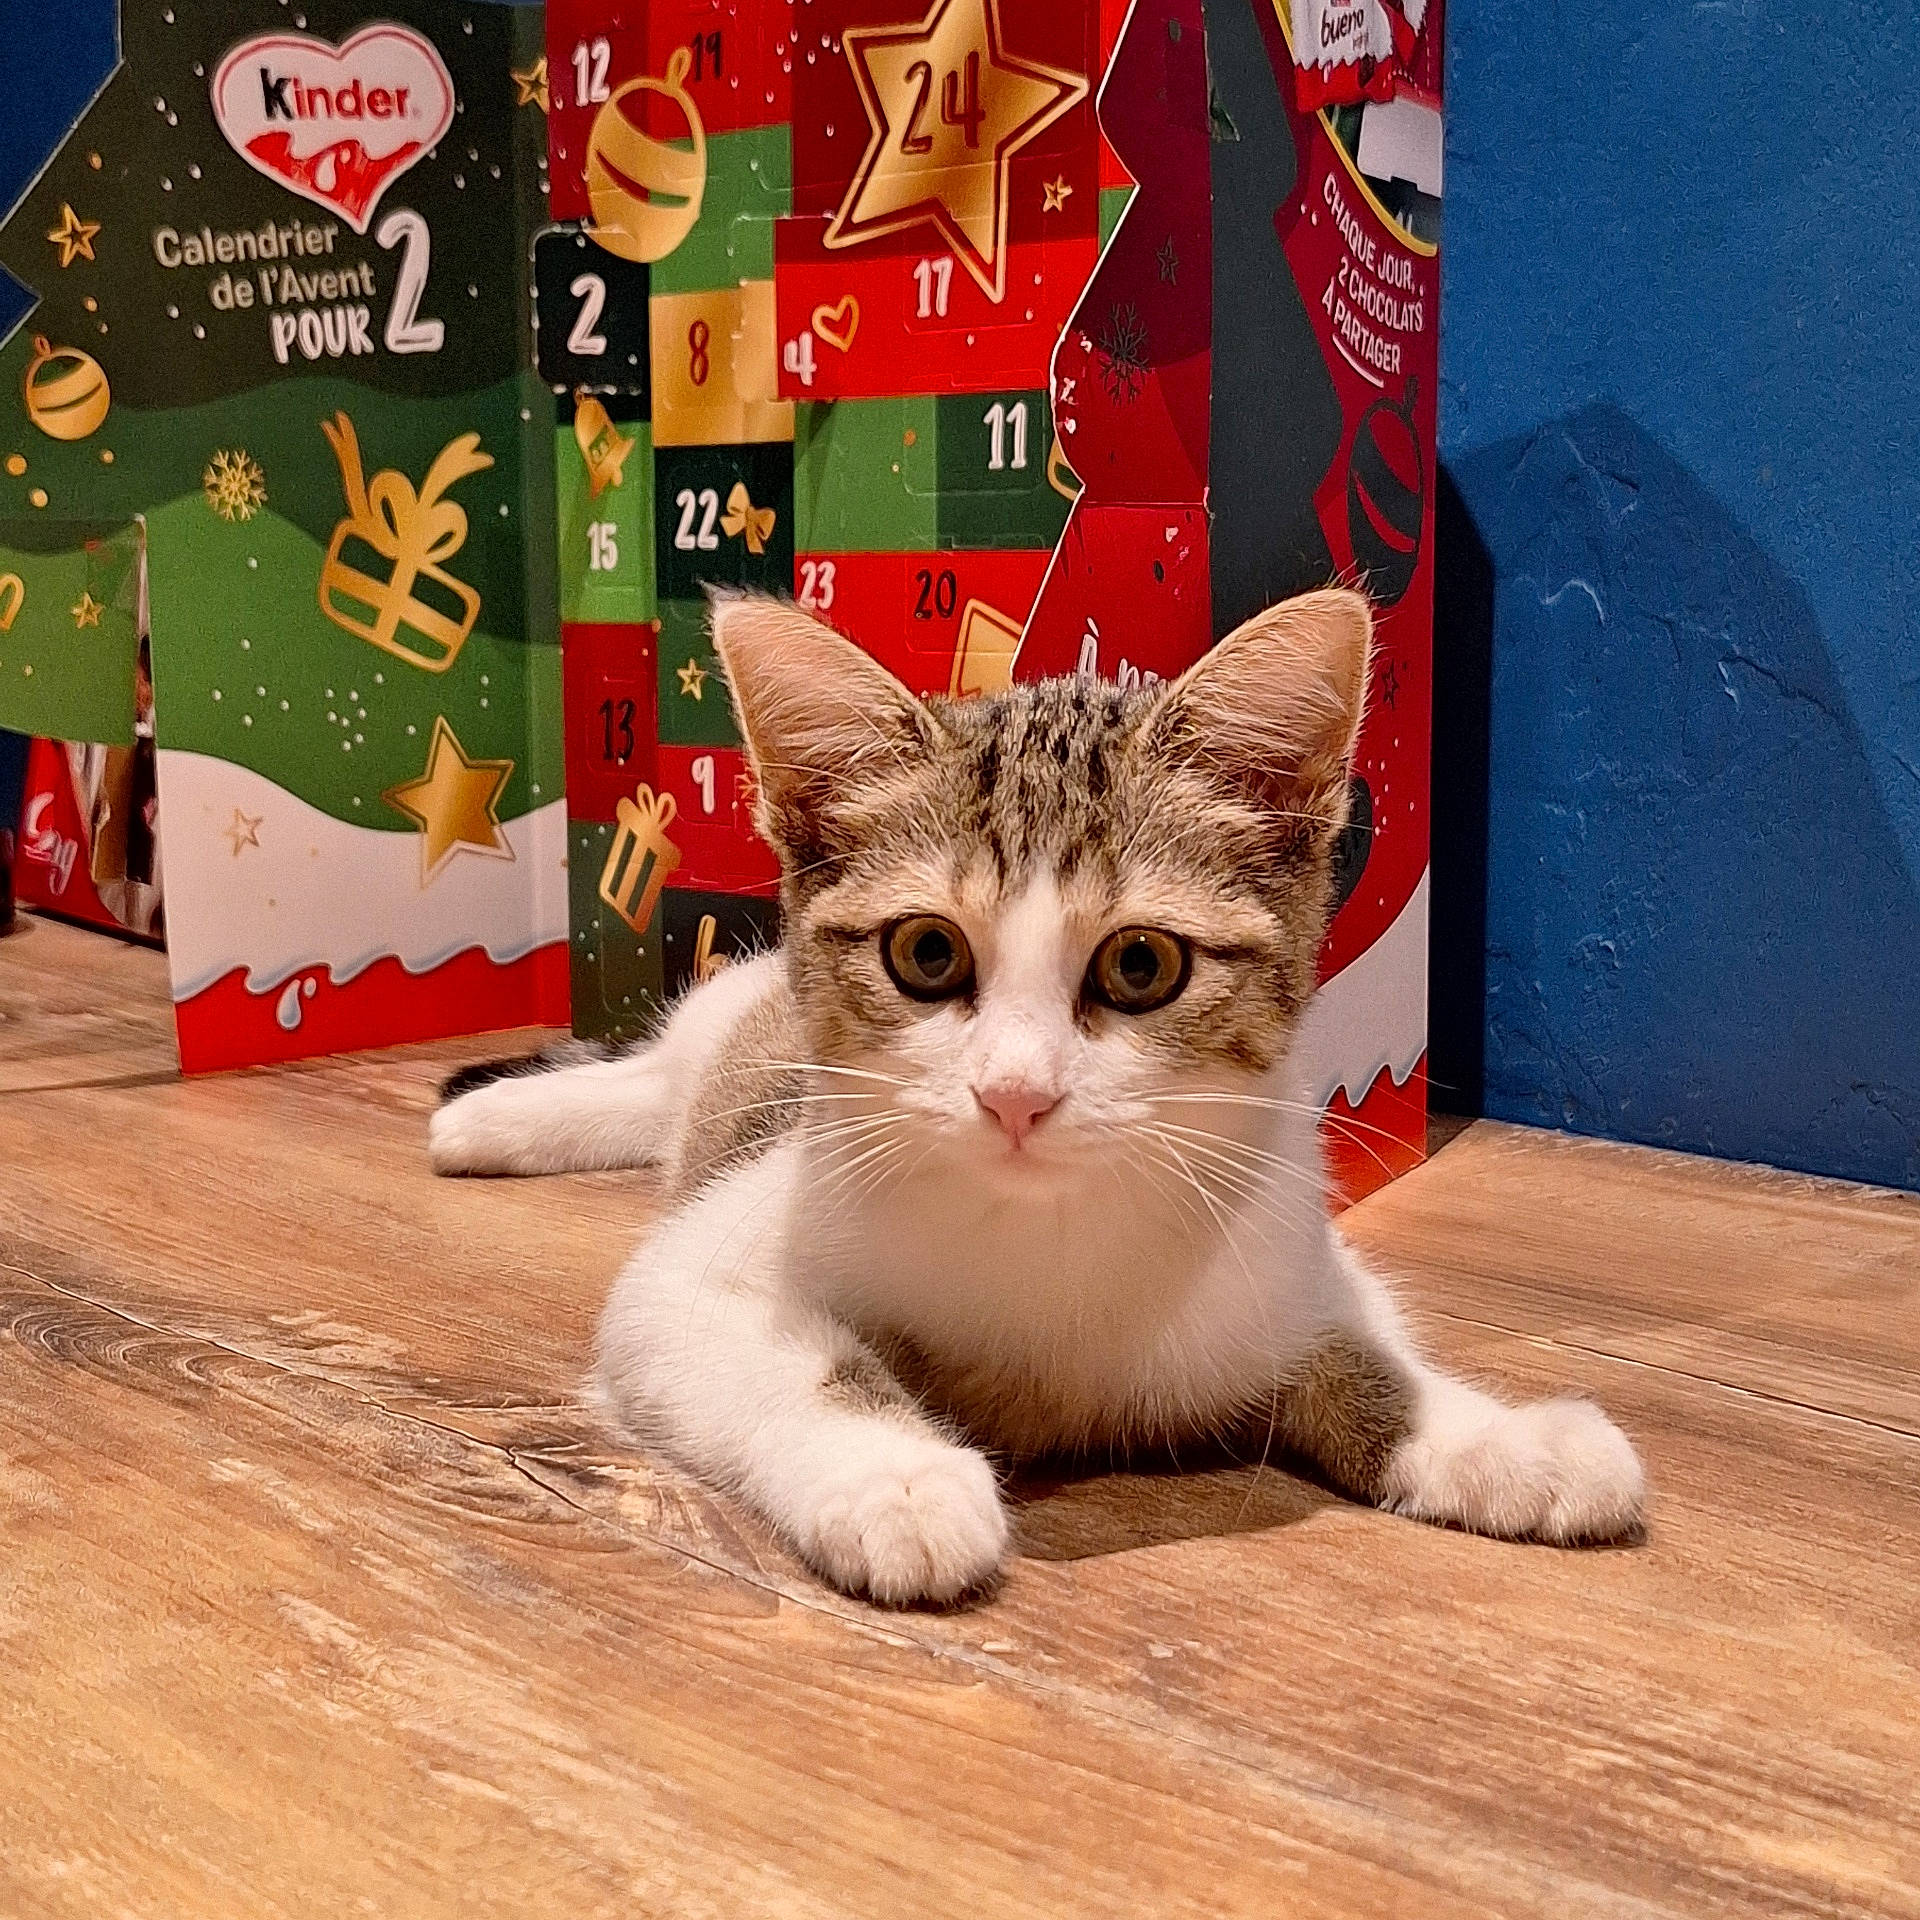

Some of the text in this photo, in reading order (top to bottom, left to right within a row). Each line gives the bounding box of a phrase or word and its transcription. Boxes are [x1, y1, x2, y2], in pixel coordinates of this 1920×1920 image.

[693, 31, 722, 81] 19
[1321, 8, 1365, 49] bueno
[260, 67, 409, 121] Kinder
[571, 35, 611, 107] 12
[901, 50, 986, 155] 24
[154, 218, 339, 268] Calendrier
[1323, 172, 1376, 272] CHAQUE
[209, 260, 377, 311] de l'Avent
[269, 206, 445, 364] POUR 2
[567, 272, 608, 355] 2
[913, 255, 954, 318] 17
[1338, 256, 1424, 333] 2 CHOCOLATS
[689, 319, 709, 387] 8
[783, 331, 818, 387] 4
[1333, 297, 1402, 376] PARTAGER
[983, 401, 1027, 470] 11
[586, 520, 618, 571] 15
[674, 488, 719, 550] 22
[799, 561, 836, 610] 23
[913, 569, 956, 619] 20
[599, 698, 636, 764] 13
[691, 754, 715, 815] 9
